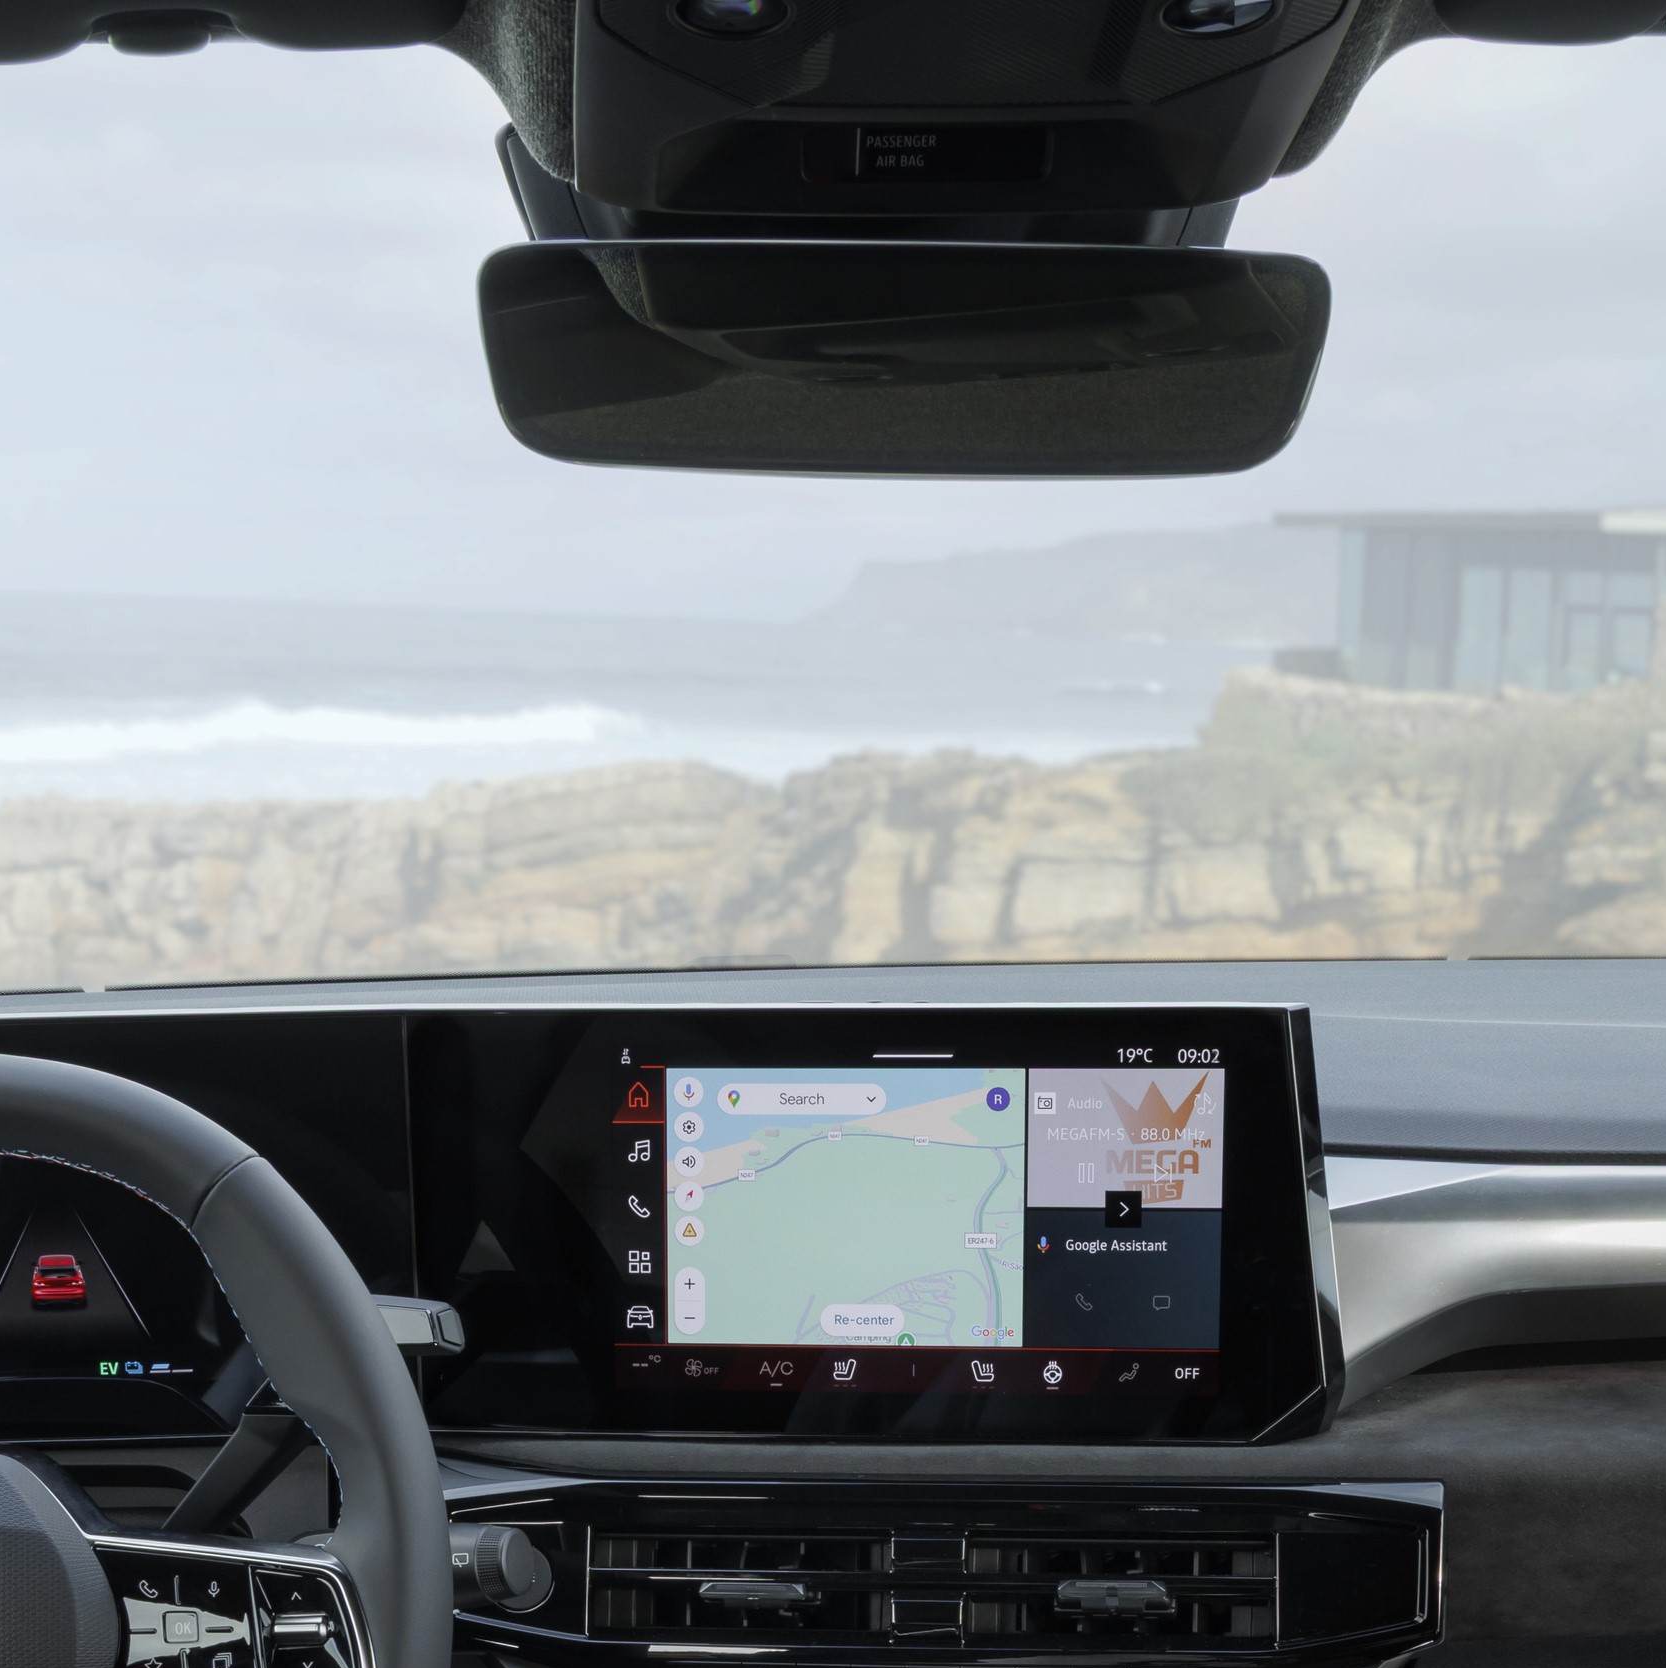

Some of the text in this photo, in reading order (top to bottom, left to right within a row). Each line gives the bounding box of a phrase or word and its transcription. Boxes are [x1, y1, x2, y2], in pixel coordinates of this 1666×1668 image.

[866, 135, 936, 148] PASSENGER
[876, 155, 924, 167] AIR BAG
[1117, 1048, 1153, 1063] 19°C
[1177, 1048, 1220, 1063] 09:02
[779, 1092, 825, 1106] Search
[993, 1094, 1003, 1105] R
[1067, 1097, 1103, 1110] Audio
[1047, 1127, 1206, 1141] MEGAFM-S 88.0 MHz
[1192, 1138, 1212, 1148] FM
[1105, 1150, 1200, 1174] MEGA
[740, 1171, 753, 1179] N247
[1065, 1239, 1168, 1254] Google Assistant
[834, 1314, 895, 1325] Re-center
[971, 1325, 1015, 1340] Google
[99, 1362, 119, 1375] EV
[704, 1367, 719, 1375] OFF
[759, 1360, 794, 1378] A/C
[1175, 1367, 1200, 1379] OFF
[175, 1621, 191, 1635] OK
